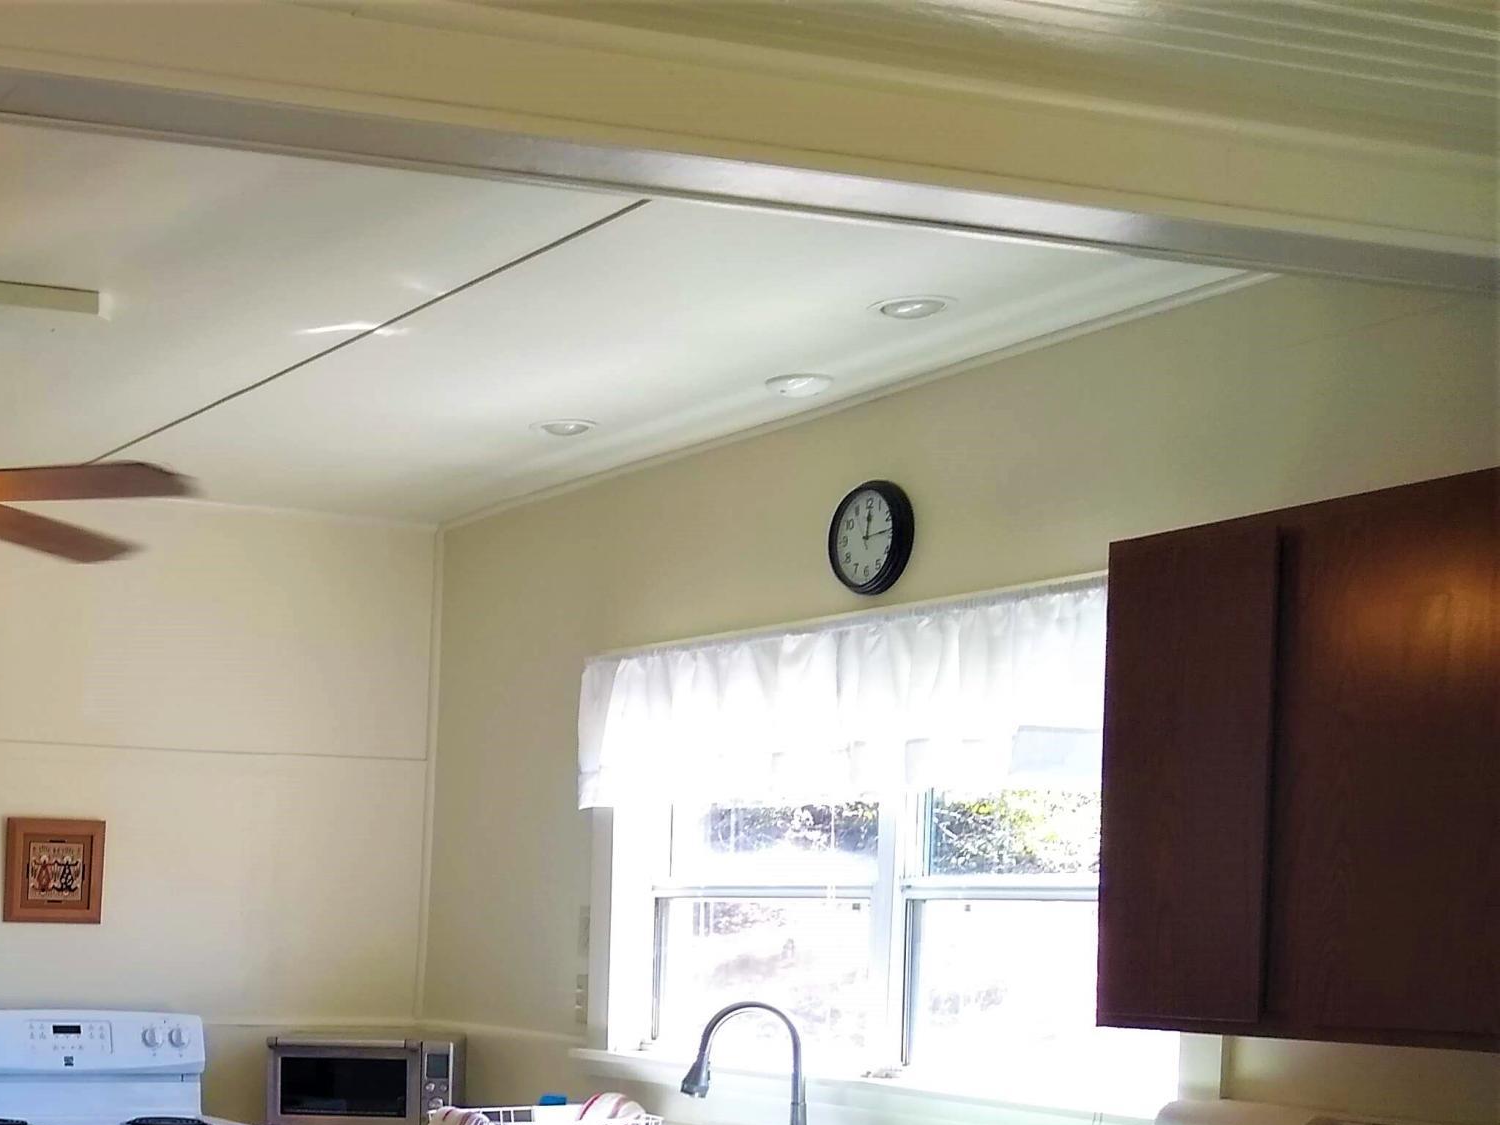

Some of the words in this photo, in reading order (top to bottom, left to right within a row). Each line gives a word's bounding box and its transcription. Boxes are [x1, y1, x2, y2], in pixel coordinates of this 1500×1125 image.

[885, 511, 892, 522] 2
[846, 518, 854, 531] 10
[842, 535, 849, 548] 9
[845, 552, 852, 564] 8
[875, 558, 881, 570] 5
[853, 562, 859, 574] 7
[863, 565, 870, 578] 6
